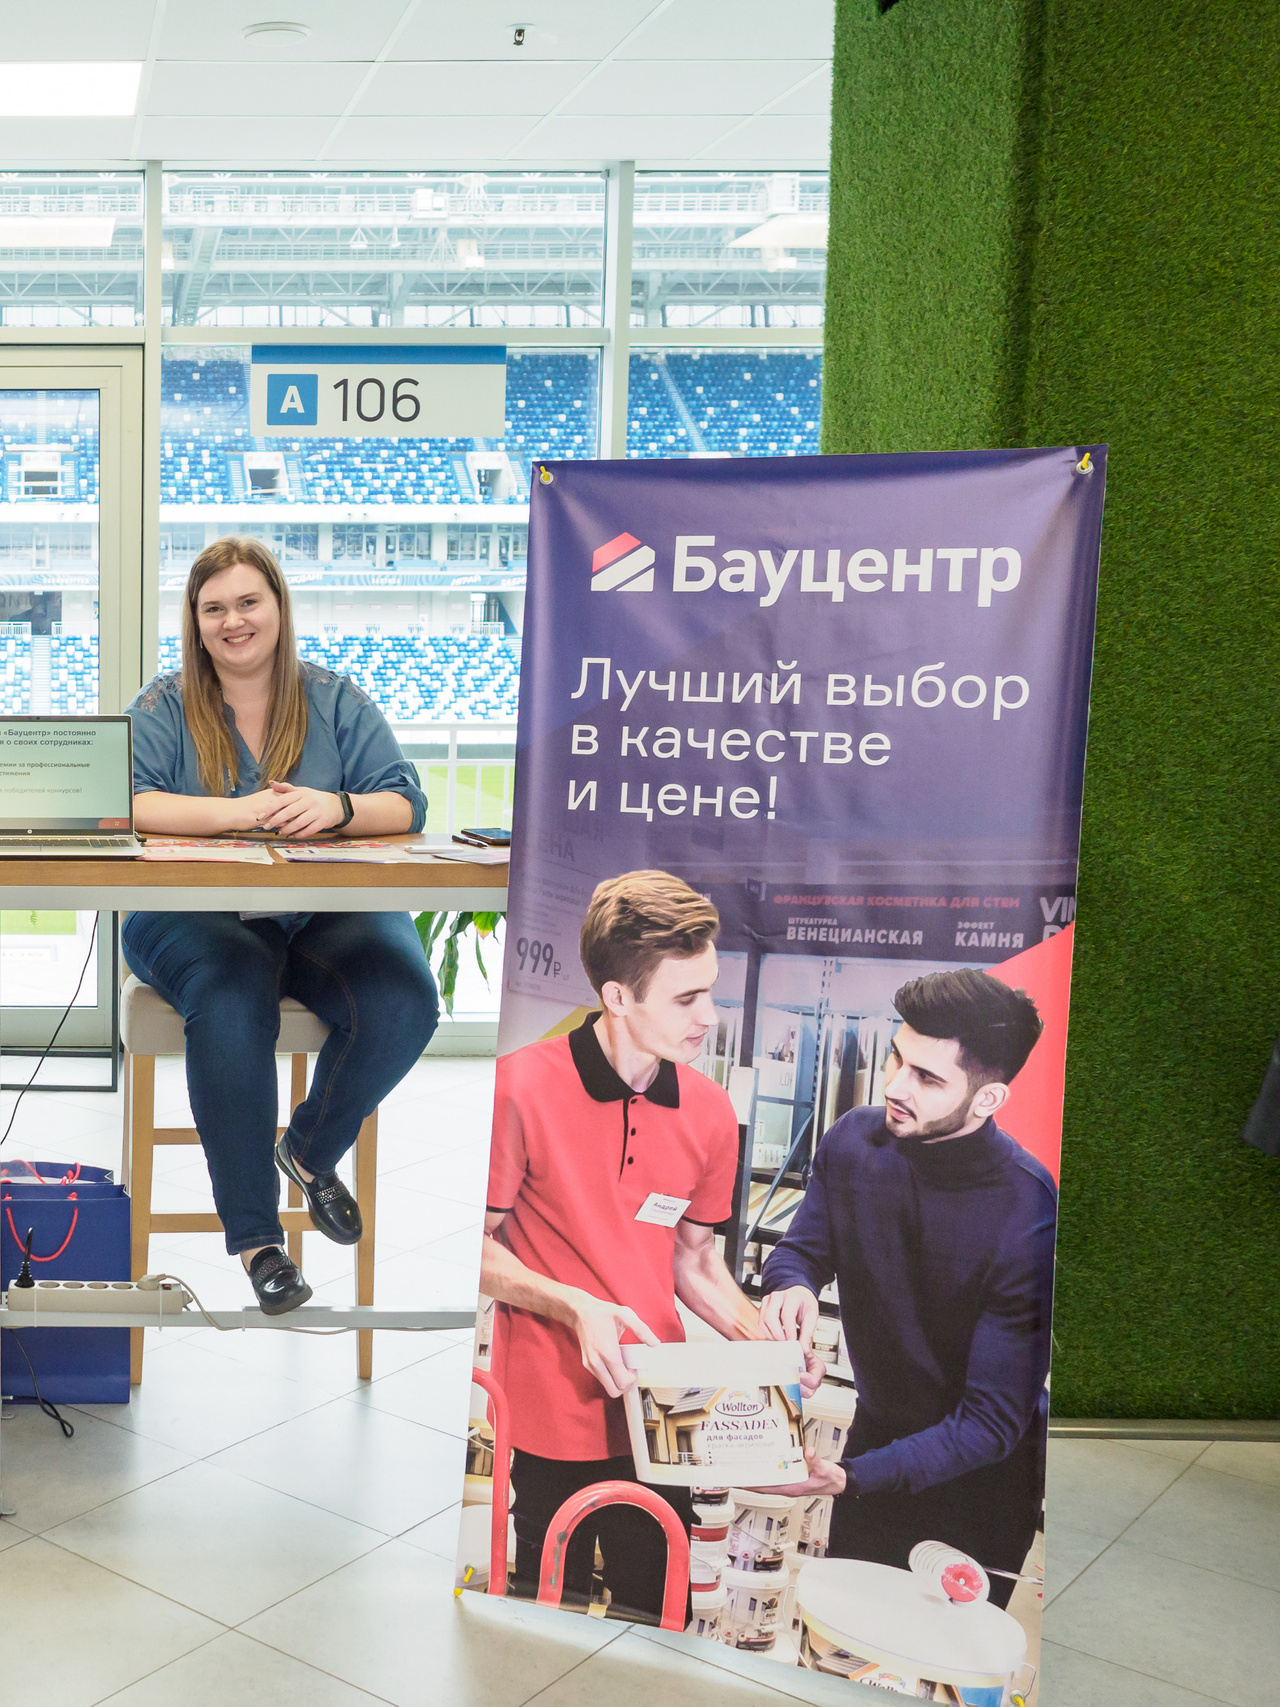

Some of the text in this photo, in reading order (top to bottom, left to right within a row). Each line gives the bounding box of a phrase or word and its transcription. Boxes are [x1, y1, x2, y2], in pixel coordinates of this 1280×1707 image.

[334, 378, 420, 422] 106
[673, 536, 1022, 607] Бауцентр
[571, 657, 1030, 720] Лучший выбор
[3, 728, 51, 738] «Бауцентр»
[40, 739, 93, 747] сотрудниках:
[572, 725, 892, 766] в качестве
[27, 761, 90, 769] профессиональные
[567, 776, 778, 822] и цене!
[773, 895, 1020, 909] ФРАНЦУЗСКАЯ КОСМЕТИКА ДЛЯ СТЕН
[788, 917, 838, 926] ШТУКАТУРКА
[957, 921, 995, 930] ЭФФЕКТ
[786, 926, 923, 945] ВЕНЕЦИАНСКАЯ
[955, 931, 1024, 948] КАМНЯ
[722, 1402, 759, 1412] Wollton
[700, 1418, 779, 1431] FASSADEN
[726, 1434, 764, 1442] фасадов
